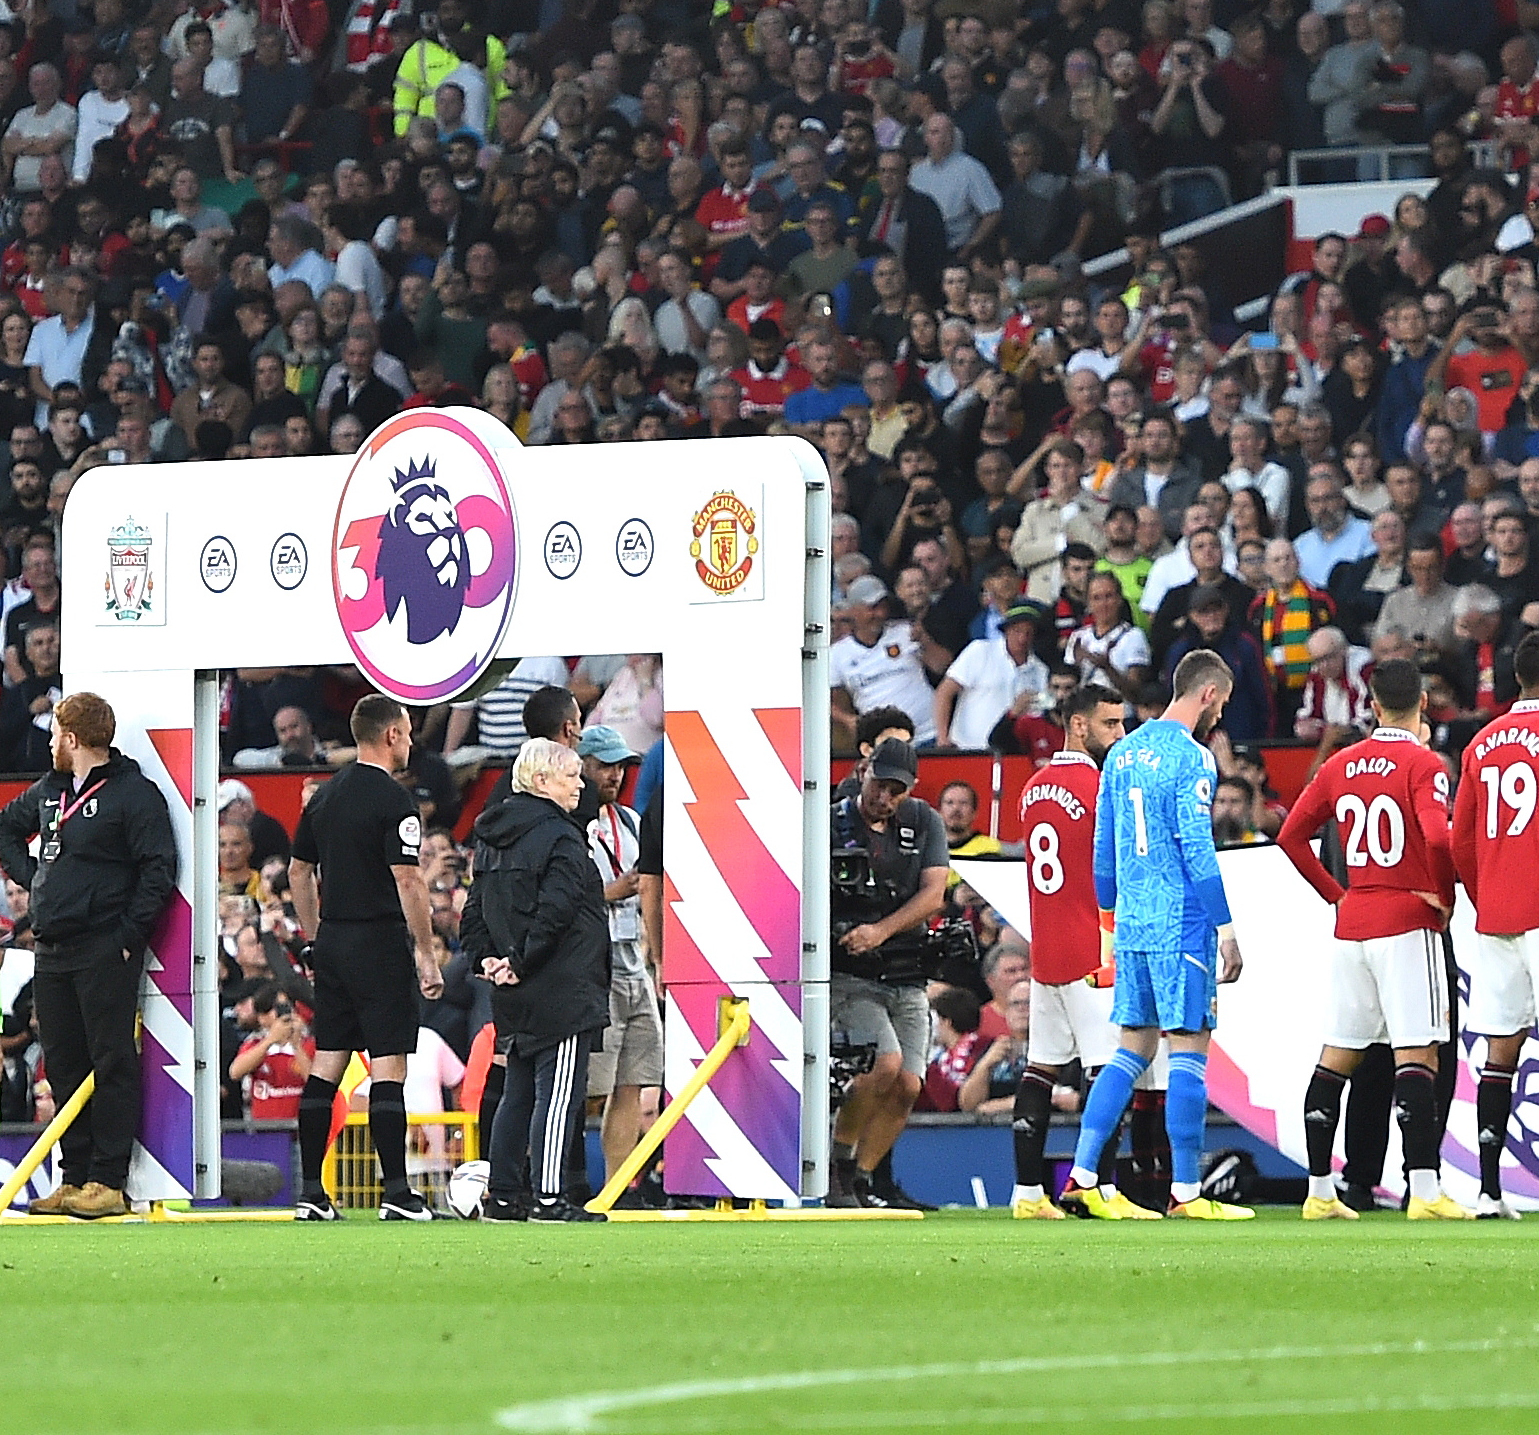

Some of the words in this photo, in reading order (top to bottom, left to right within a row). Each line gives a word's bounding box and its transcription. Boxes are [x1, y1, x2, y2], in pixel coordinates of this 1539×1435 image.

[695, 497, 752, 532] MANCHESTER
[551, 534, 575, 553] EA
[623, 531, 647, 550] EA
[207, 549, 230, 567] EA
[277, 546, 301, 564] EA
[705, 570, 745, 590] UNITED
[1116, 750, 1134, 770] DE
[1137, 749, 1161, 771] GEA
[1345, 756, 1397, 779] DALOT
[1480, 761, 1537, 839] 19
[1128, 787, 1148, 856] 1
[1335, 794, 1405, 867] 20
[1029, 822, 1064, 894] 8
